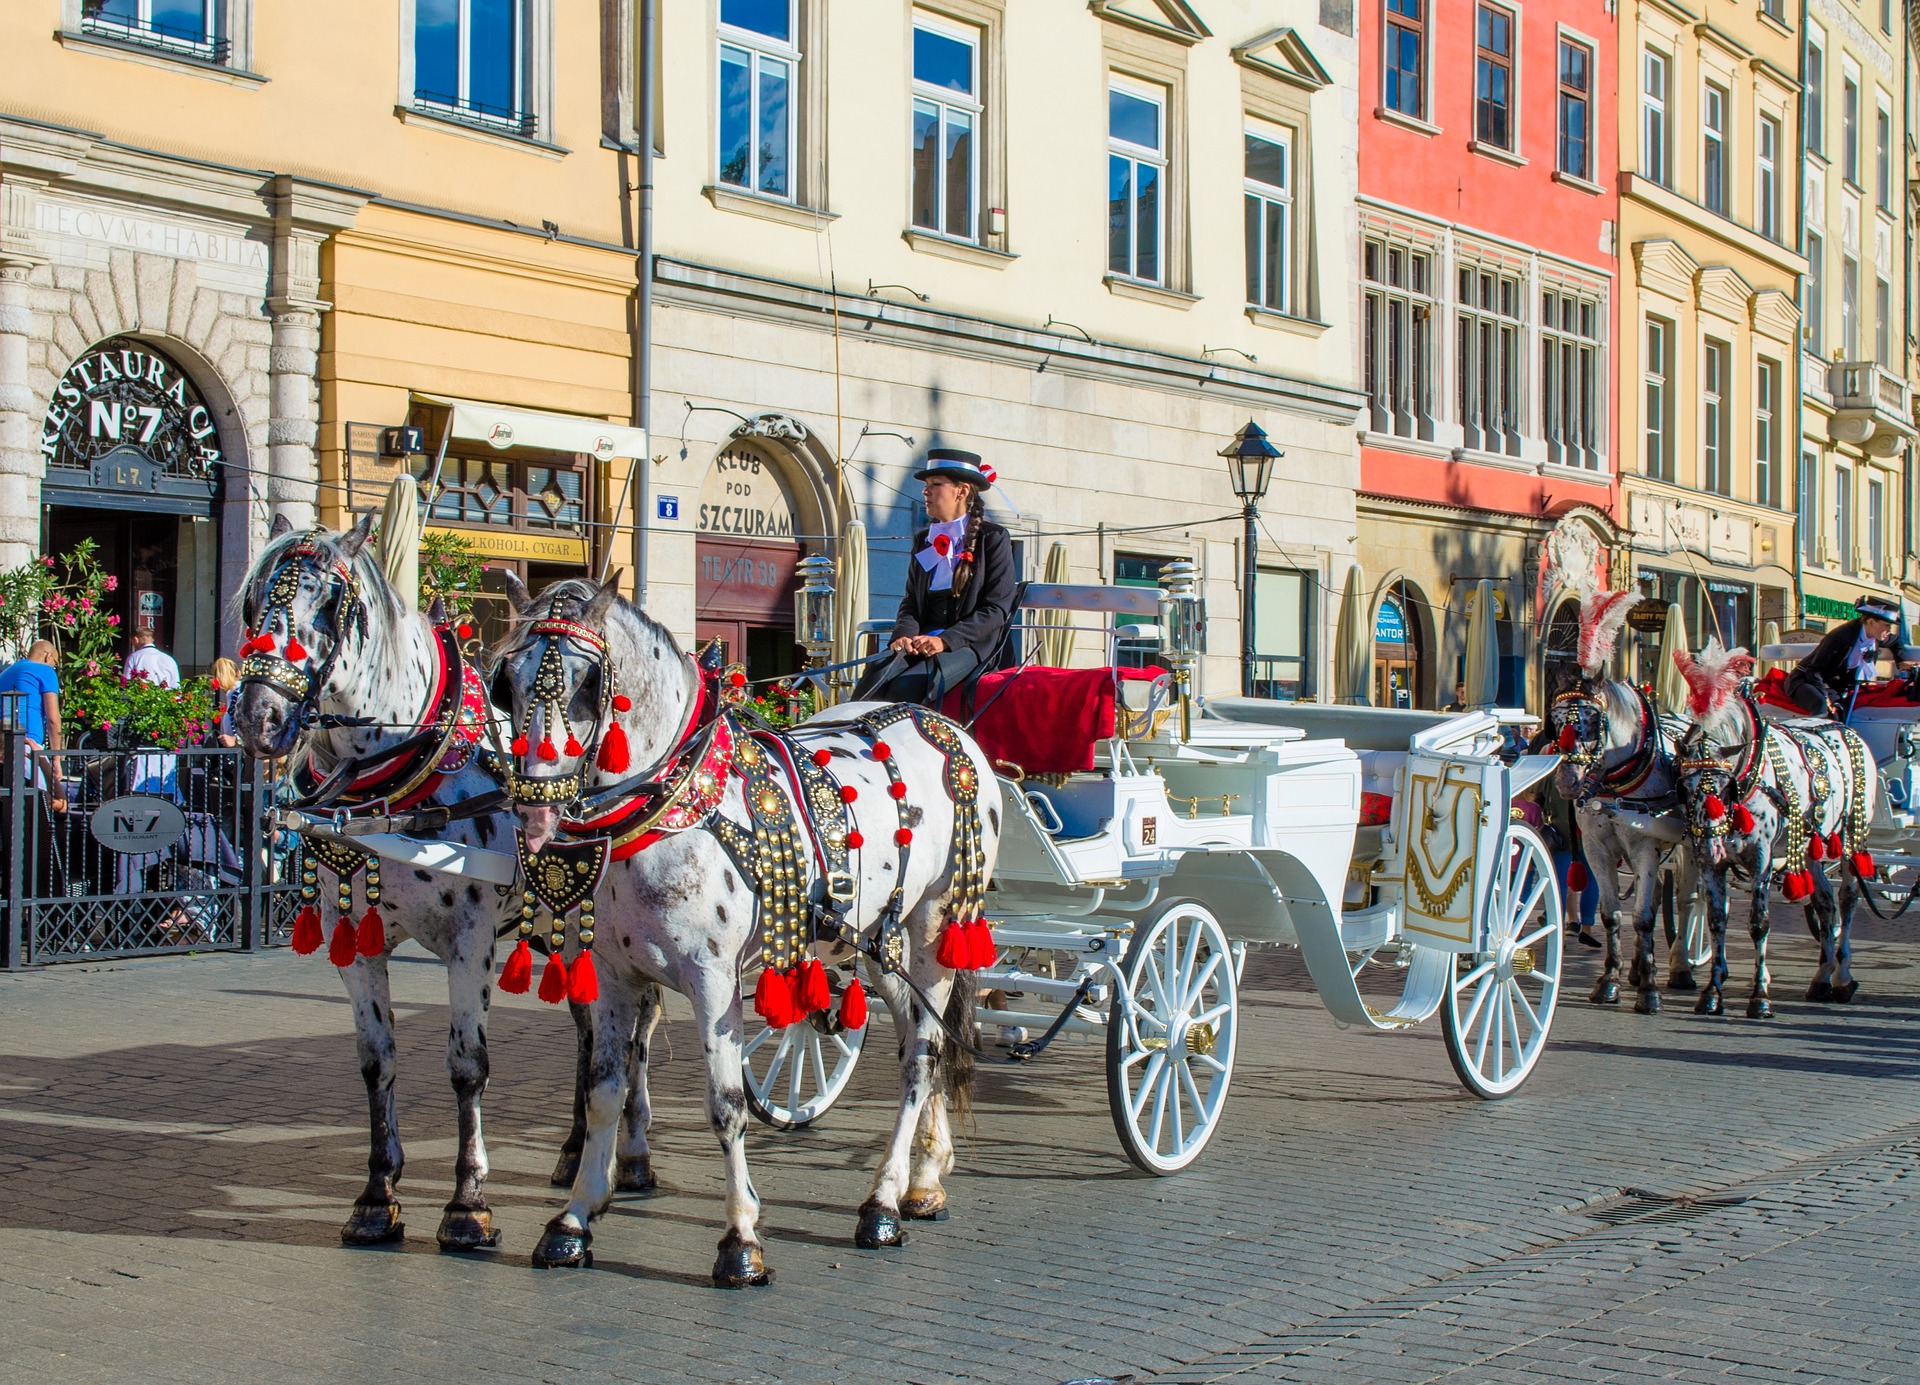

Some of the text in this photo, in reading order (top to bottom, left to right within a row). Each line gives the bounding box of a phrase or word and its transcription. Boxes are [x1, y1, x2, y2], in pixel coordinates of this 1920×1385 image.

[40, 203, 265, 268] TECVM HABITA
[40, 349, 223, 473] RESTAURACJA
[716, 450, 761, 475] KLUB
[726, 482, 752, 496] POD
[665, 503, 673, 517] 8
[696, 503, 795, 536] SZCZURAMI
[532, 541, 570, 556] CYGAR
[703, 555, 777, 587] TEATR 38
[1376, 627, 1403, 639] ANTOR
[1143, 829, 1156, 845] 24
